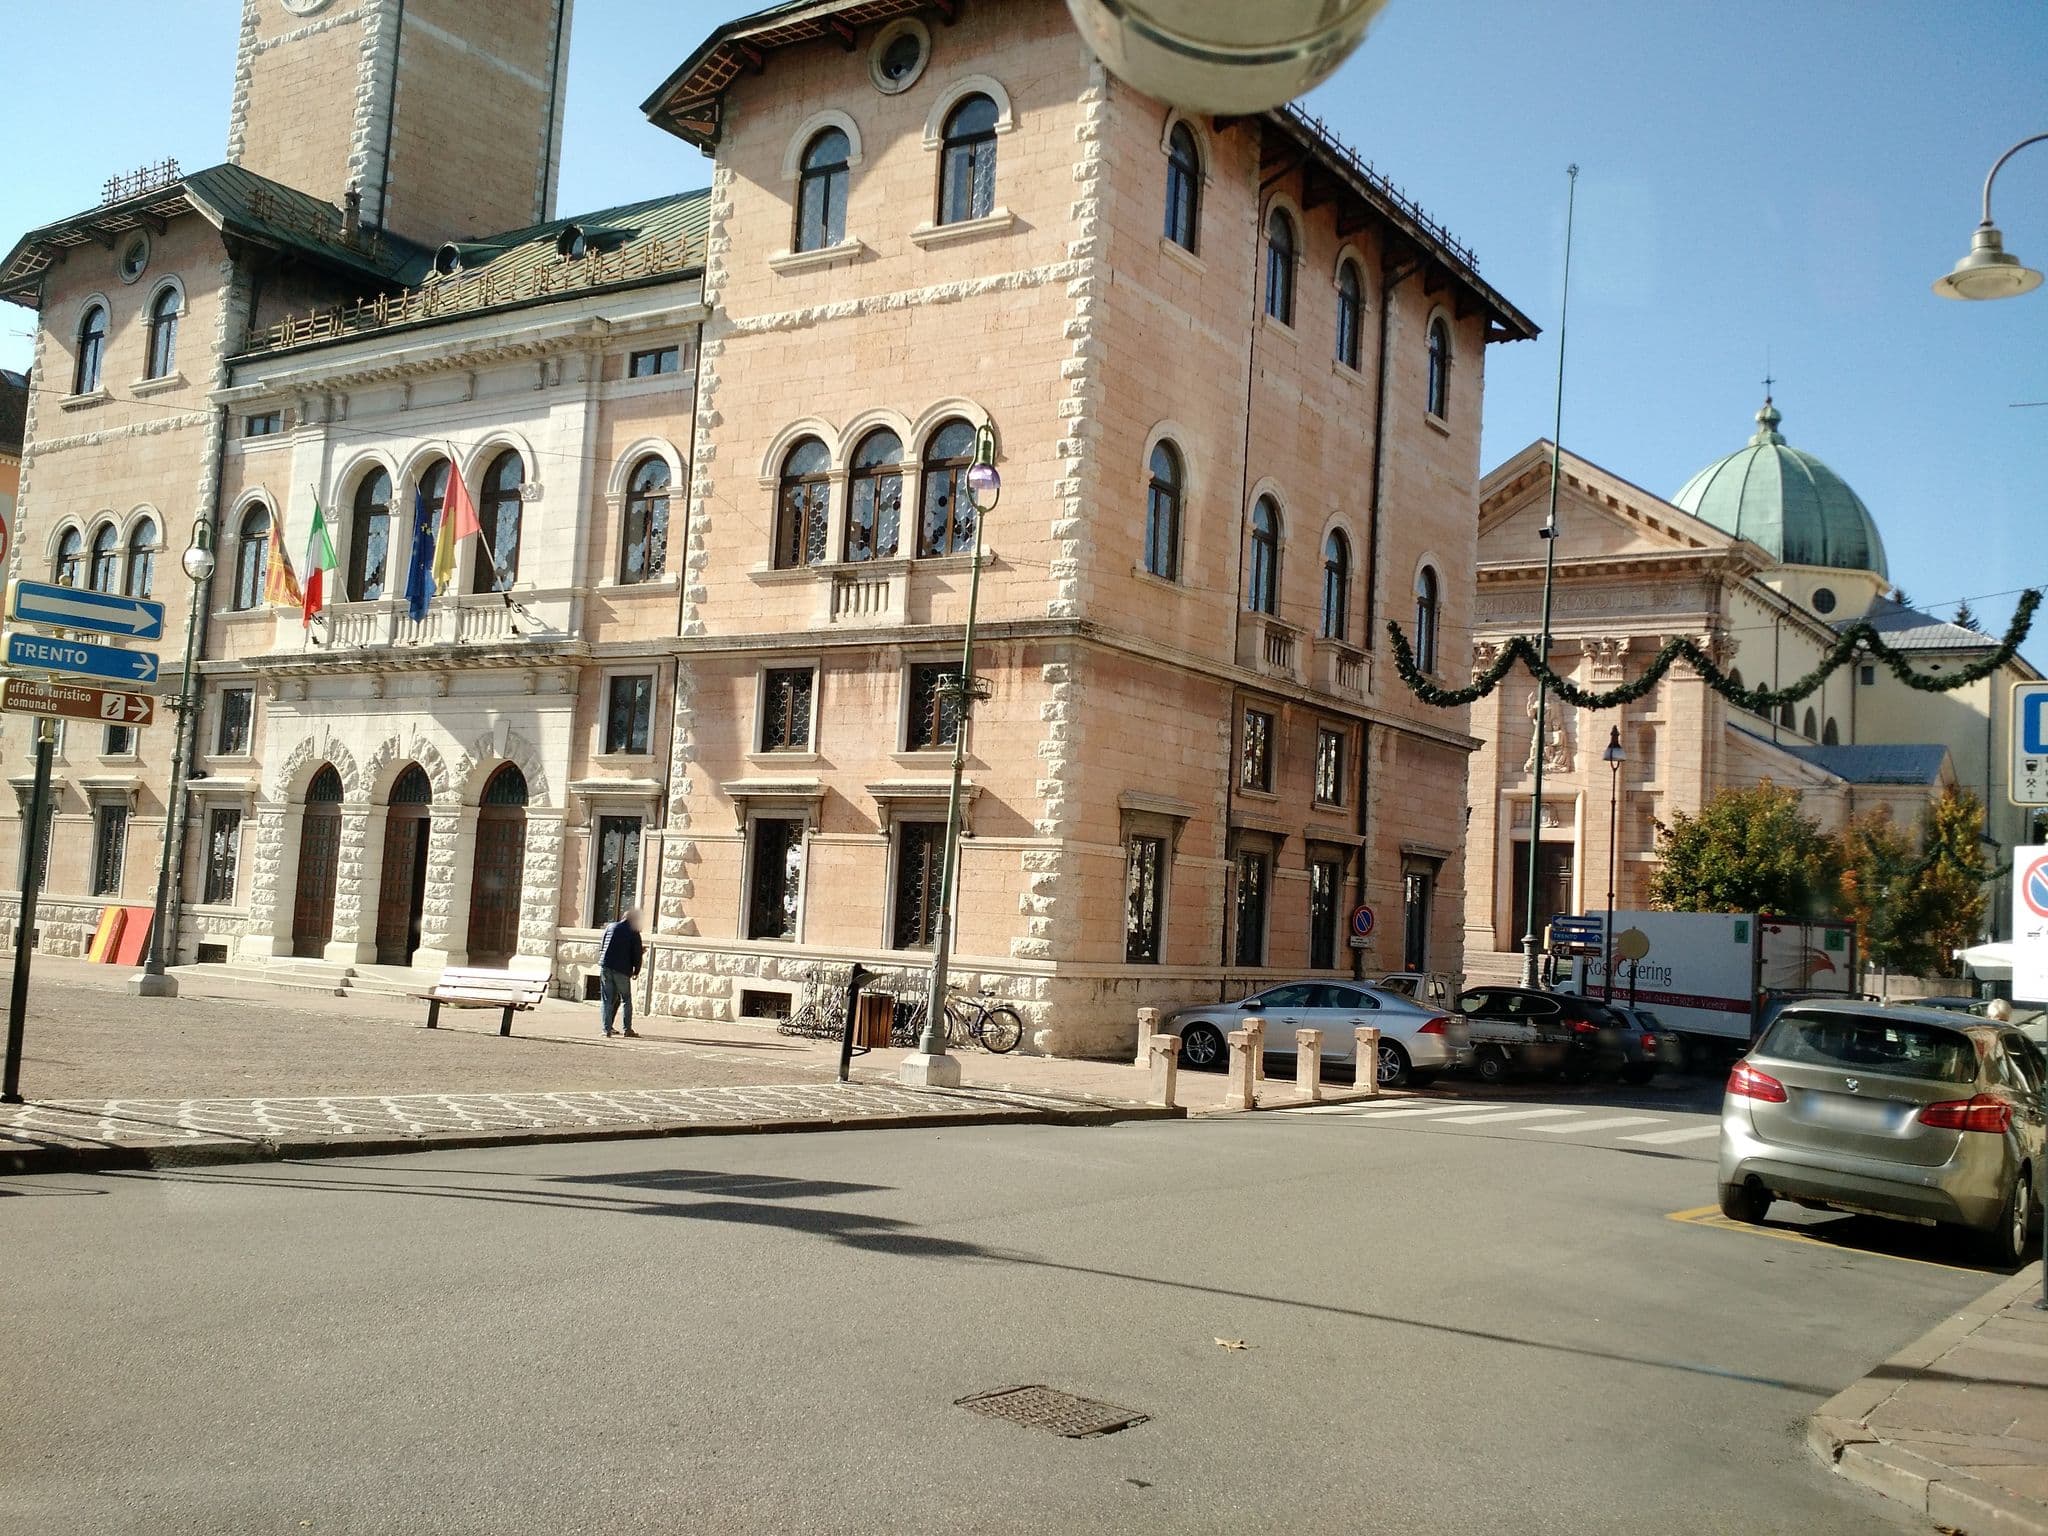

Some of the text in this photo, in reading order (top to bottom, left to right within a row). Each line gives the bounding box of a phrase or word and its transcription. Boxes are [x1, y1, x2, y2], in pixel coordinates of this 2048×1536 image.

[14, 641, 88, 665] TRENTO
[9, 681, 92, 703] ufficio turistico
[7, 696, 58, 712] comunale
[1553, 932, 1578, 940] TRENTO
